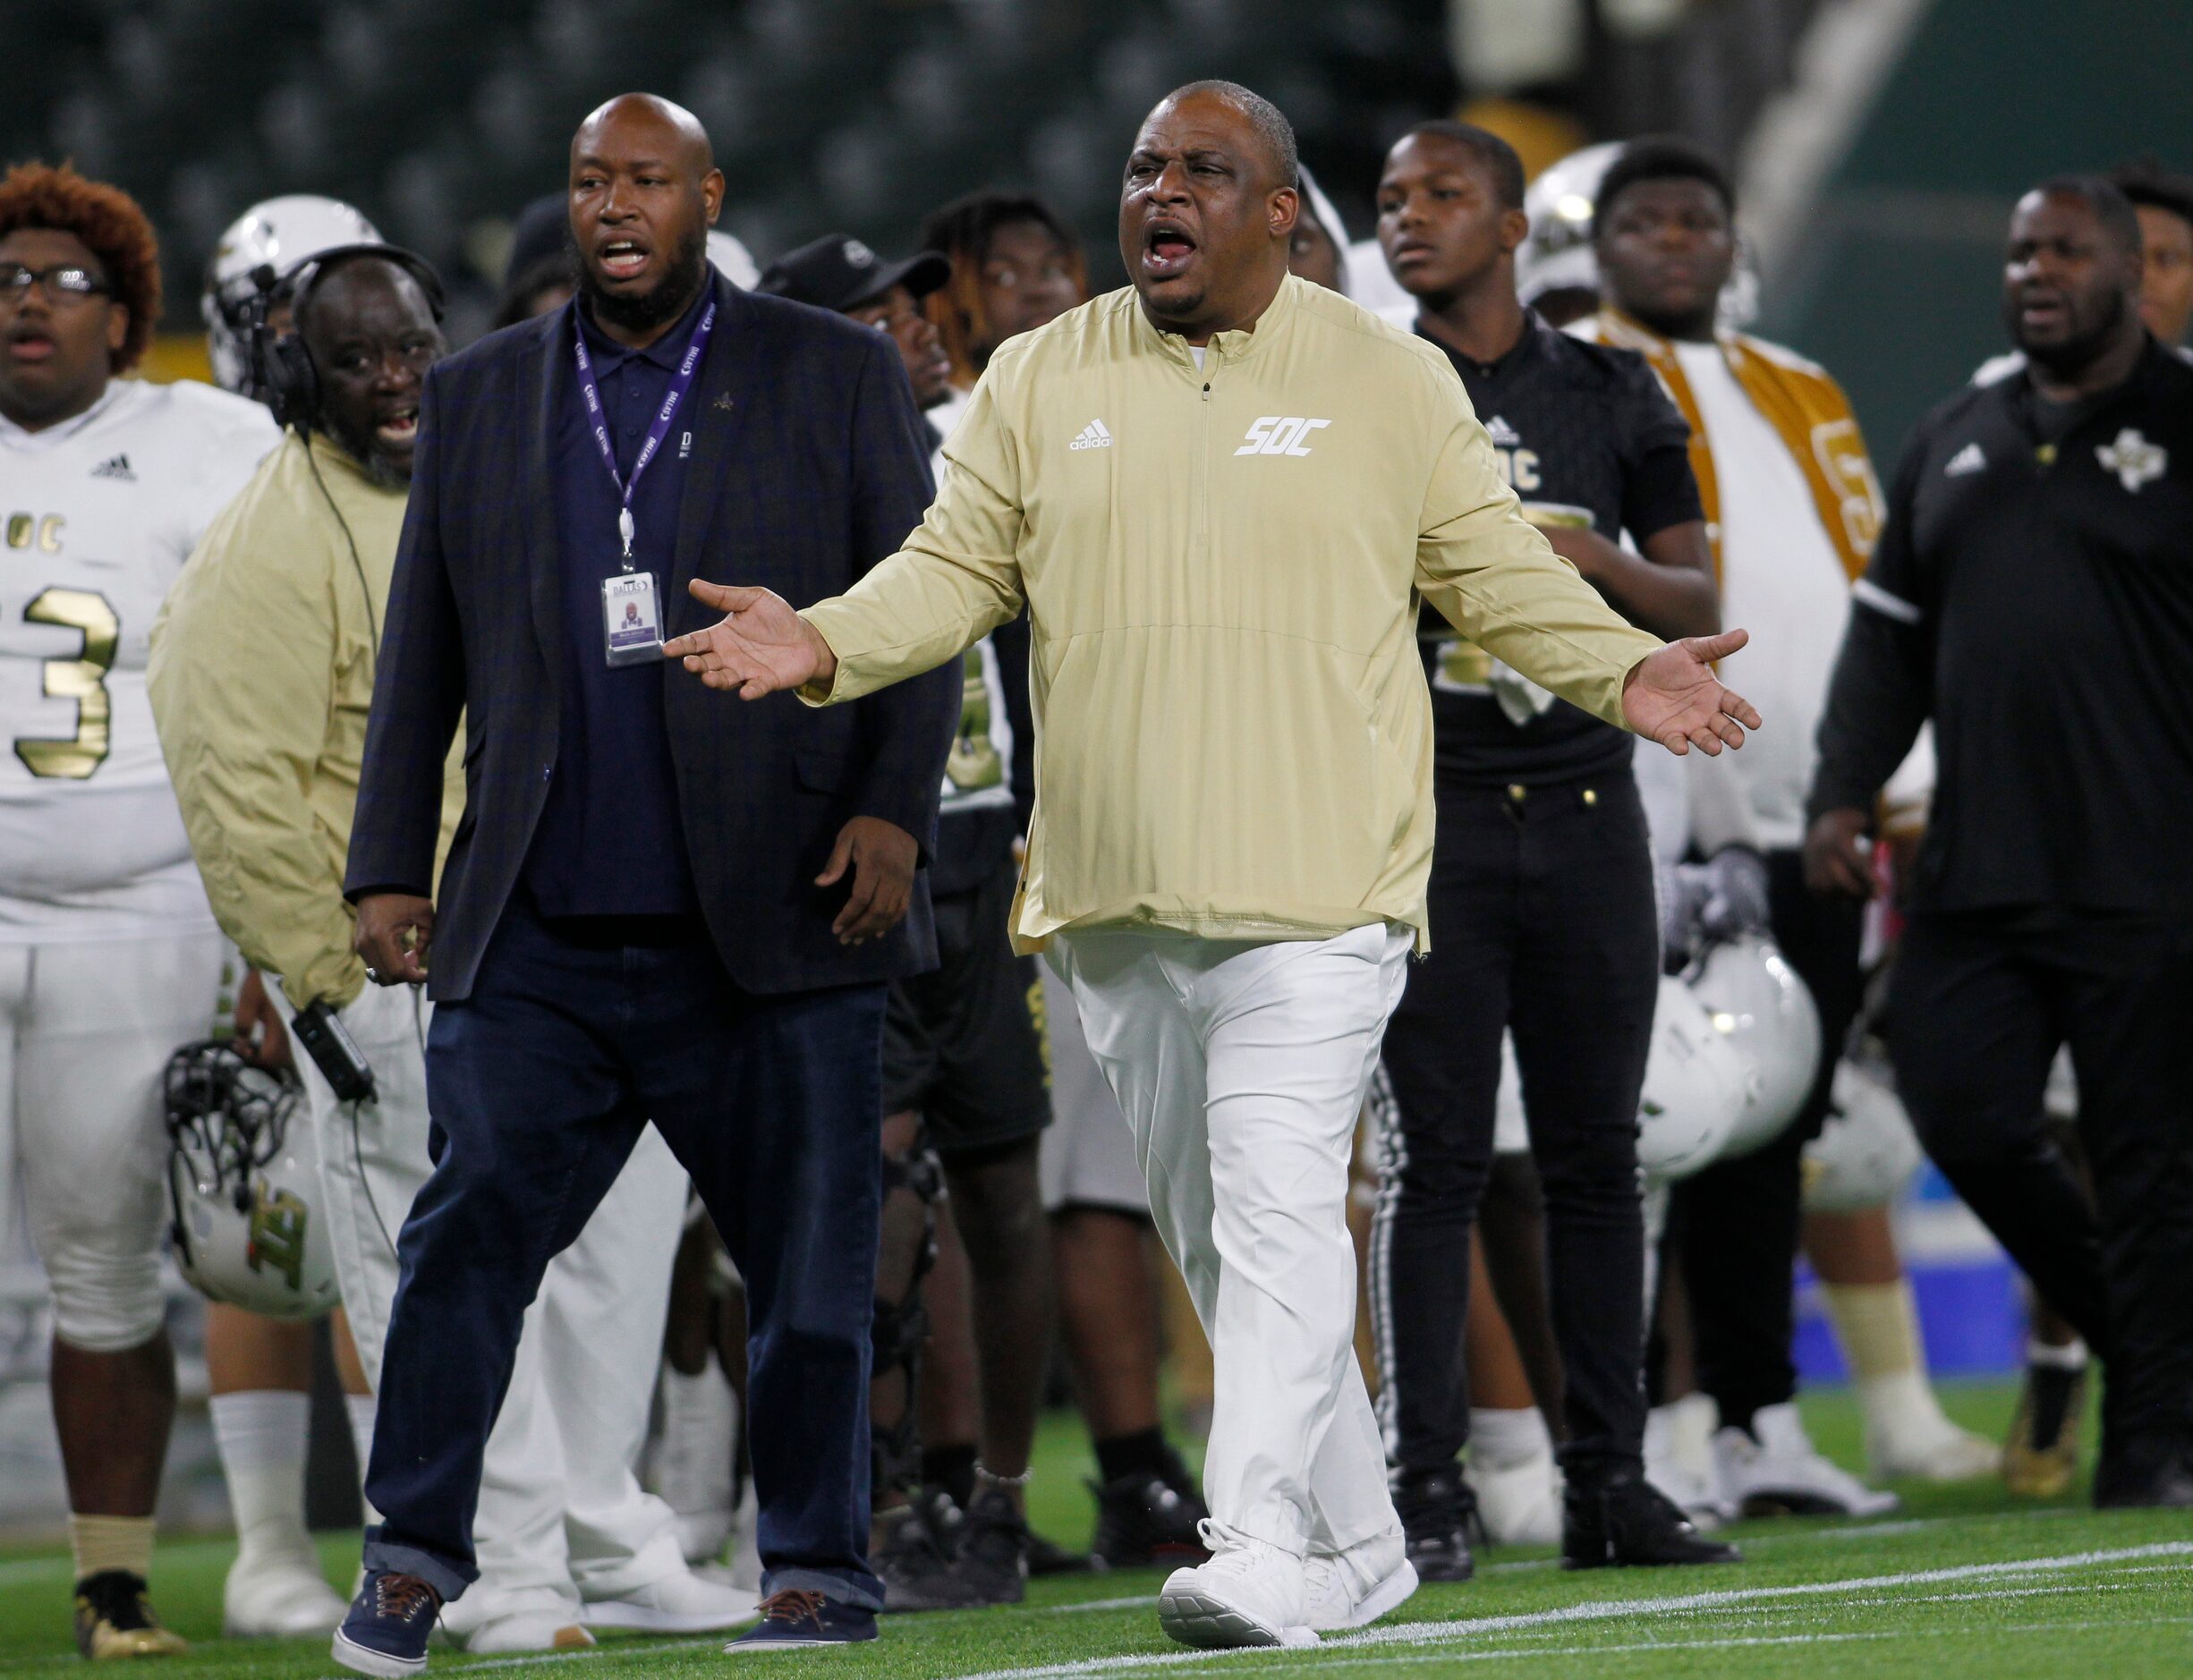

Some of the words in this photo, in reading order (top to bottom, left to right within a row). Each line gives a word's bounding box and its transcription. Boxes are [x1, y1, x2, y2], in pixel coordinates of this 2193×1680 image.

[1069, 437, 1112, 450] adida
[1234, 416, 1332, 457] SOC
[0, 512, 66, 554] OC
[613, 581, 642, 594] DALLAS
[0, 586, 120, 780] 3
